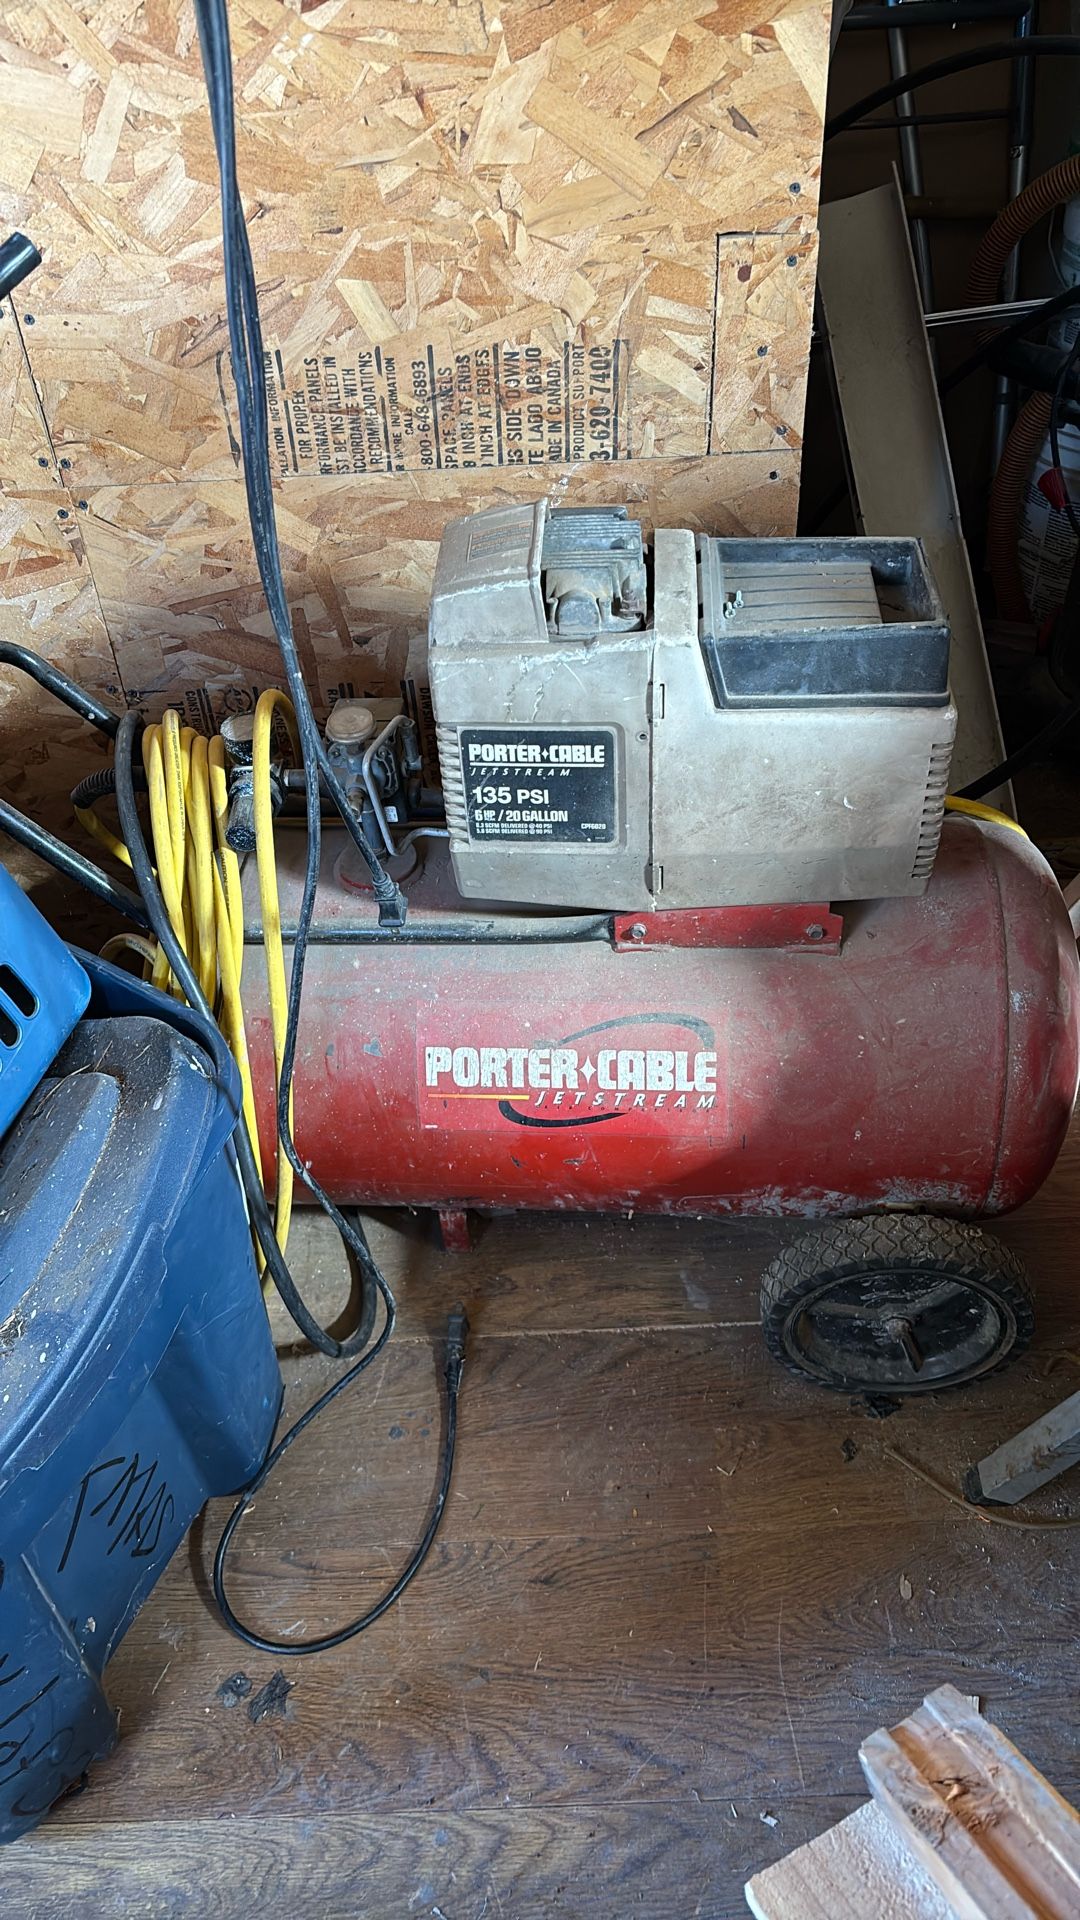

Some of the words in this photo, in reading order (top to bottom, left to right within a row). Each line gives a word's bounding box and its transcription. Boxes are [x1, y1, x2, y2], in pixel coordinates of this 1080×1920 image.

[304, 358, 322, 402] PANELS
[323, 356, 336, 368] IN
[456, 355, 472, 392] ENDS
[475, 350, 490, 395] EDGES
[504, 352, 520, 398] DOWN
[525, 348, 542, 395] ABAJO
[571, 344, 584, 400] SUPPORT
[264, 351, 280, 422] INFORMATION
[341, 368, 356, 398] WITH
[384, 357, 401, 427] INFORMATION
[438, 368, 455, 421] PANELS
[547, 360, 561, 415] CANADA
[292, 390, 310, 434] PROPER
[324, 374, 345, 434] INSTALLED
[358, 352, 383, 464] RECOMMENDATIONS
[458, 399, 472, 416] AT
[478, 403, 492, 419] AT
[527, 404, 543, 442] LADO
[461, 422, 475, 454] INCH
[479, 425, 493, 457] INCH
[506, 408, 522, 441] SIDE
[547, 421, 562, 433] IN
[572, 407, 585, 460] PRODUCT
[298, 440, 313, 459] FOR
[333, 436, 346, 452] BE
[443, 429, 458, 469] SPACE
[420, 687, 434, 730] DAWSON
[470, 768, 571, 777] JETSTREAM
[472, 787, 511, 804] 135
[517, 789, 549, 804] PSI
[505, 810, 520, 822] 20
[522, 810, 568, 822] GALLON
[535, 1092, 715, 1110] JETSTREAM
